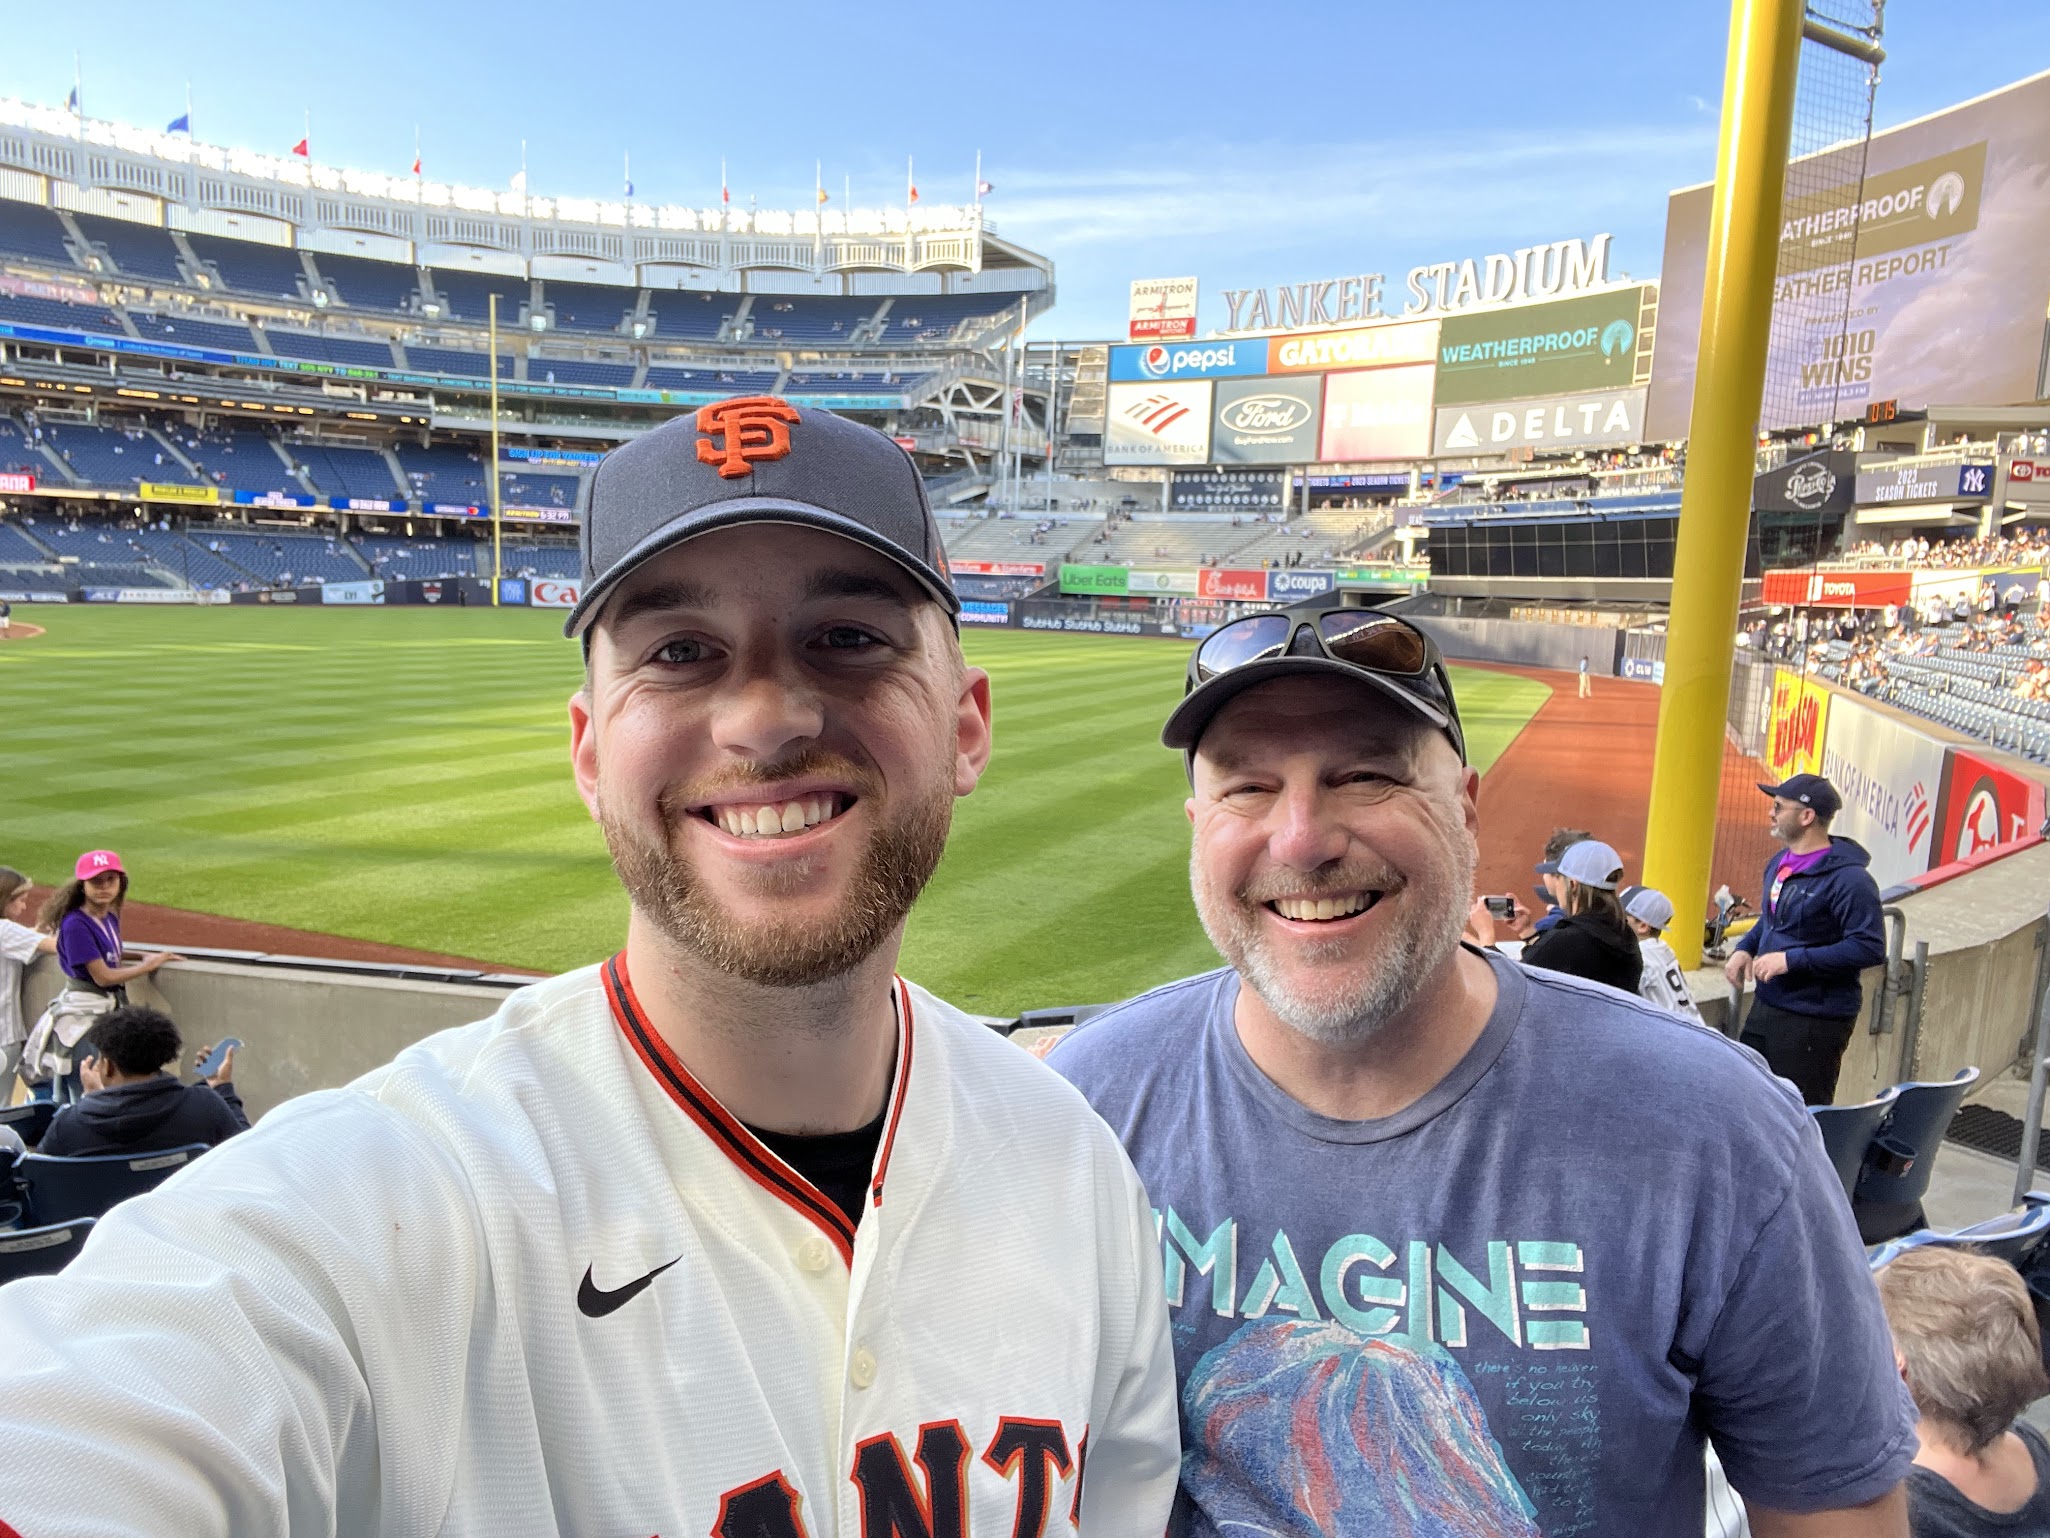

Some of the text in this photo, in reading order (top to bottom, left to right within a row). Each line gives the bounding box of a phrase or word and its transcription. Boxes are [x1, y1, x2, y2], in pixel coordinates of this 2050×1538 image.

[1780, 185, 1924, 243] ATHERPROOF
[1220, 233, 1614, 333] YANKEE STADIUM
[1775, 244, 1952, 303] ATHER REPORT
[1133, 284, 1193, 296] ARMITRON
[1867, 306, 1880, 315] BY
[1135, 320, 1188, 331] ARMITRON
[1279, 332, 1426, 366] GATORA
[1442, 327, 1598, 364] WEATHERPROOF
[1822, 329, 1876, 360] 1010
[1173, 344, 1236, 373] pepsi
[1498, 359, 1518, 368] SINCE
[1801, 356, 1872, 389] WINS
[1236, 400, 1296, 428] Ford
[1491, 400, 1630, 442] DELTA
[696, 396, 801, 480] SF
[1107, 444, 1204, 455] BANK OF AMERICA
[1898, 469, 1918, 484] 2023
[1963, 468, 1985, 492] NY
[1875, 482, 1937, 501] SEASON TICKETS
[1064, 573, 1126, 587] Uber Eats
[1291, 576, 1327, 592] coupa
[1823, 582, 1855, 596] TOYOTA
[1845, 762, 1856, 799] OF
[1856, 770, 1899, 838] AMERICA
[1152, 1204, 1590, 1350] MAGINE
[1529, 1365, 1547, 1374] no
[1529, 1380, 1564, 1395] you
[1571, 1376, 1597, 1392] try
[1521, 1405, 1600, 1426] only sky
